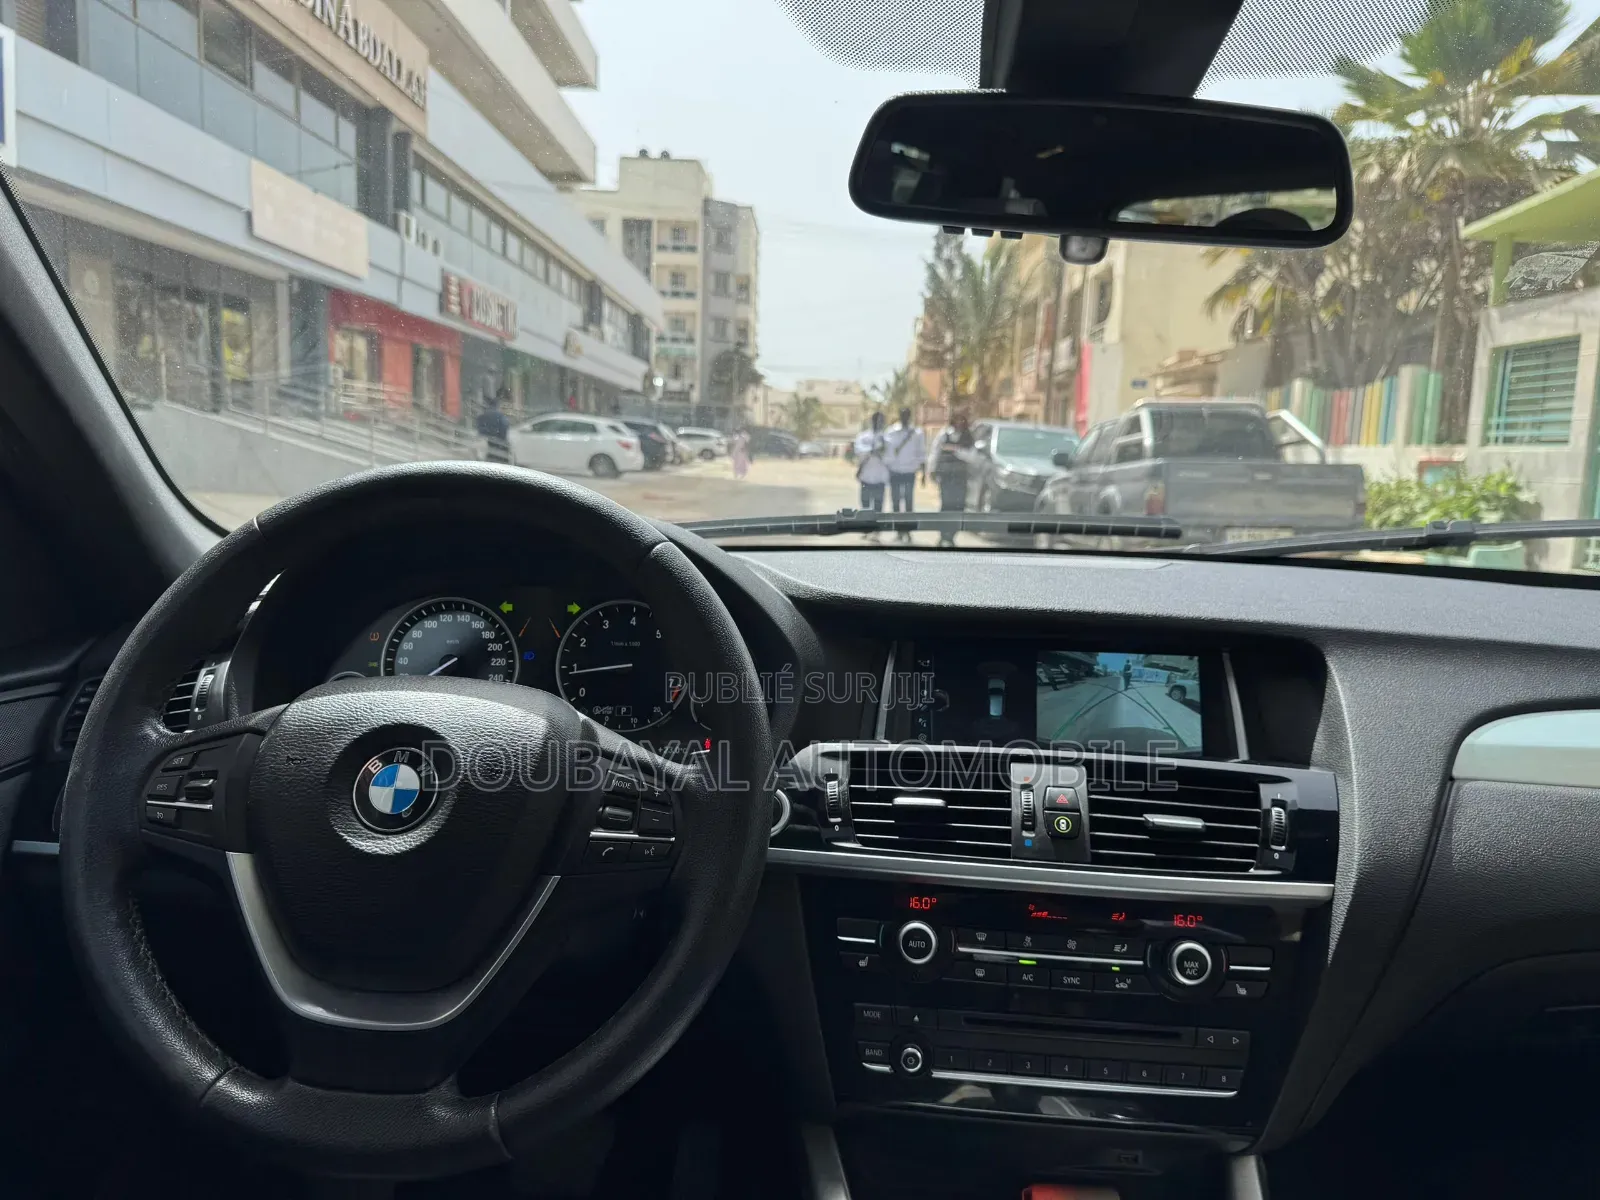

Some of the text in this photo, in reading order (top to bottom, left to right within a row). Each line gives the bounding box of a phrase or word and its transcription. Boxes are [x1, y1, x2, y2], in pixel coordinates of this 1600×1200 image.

[439, 614, 453, 622] 120
[456, 614, 470, 623] 140
[629, 616, 637, 626] 4
[424, 620, 438, 629] 100
[471, 621, 485, 629] 160
[602, 619, 610, 629] 3
[411, 630, 423, 639] 80
[481, 631, 495, 640] 180
[655, 629, 662, 639] 5
[403, 642, 414, 650] 60
[579, 637, 587, 648] 2
[487, 643, 503, 652] 200
[398, 657, 409, 665] 40
[490, 658, 506, 667] 220
[572, 663, 578, 673] 1
[488, 674, 504, 682] 240
[579, 687, 586, 697] 0
[621, 707, 627, 715] P
[172, 757, 184, 765] SET
[367, 750, 435, 777] BMW
[611, 779, 632, 789] MODE
[908, 940, 926, 949] AUTO
[1183, 960, 1199, 969] MAX
[1185, 968, 1199, 976] A/C
[1022, 973, 1034, 982] A/C
[1062, 976, 1081, 985] SYNC
[863, 1010, 881, 1019] MODE
[865, 1048, 883, 1057] BAND
[949, 1055, 954, 1063] 1
[987, 1058, 993, 1067] 2
[1025, 1061, 1031, 1070] 3
[1063, 1064, 1070, 1072] 4
[1103, 1067, 1109, 1075] 5
[1141, 1069, 1148, 1078] 6
[1180, 1072, 1186, 1080] 7
[1221, 1075, 1227, 1083] 8
